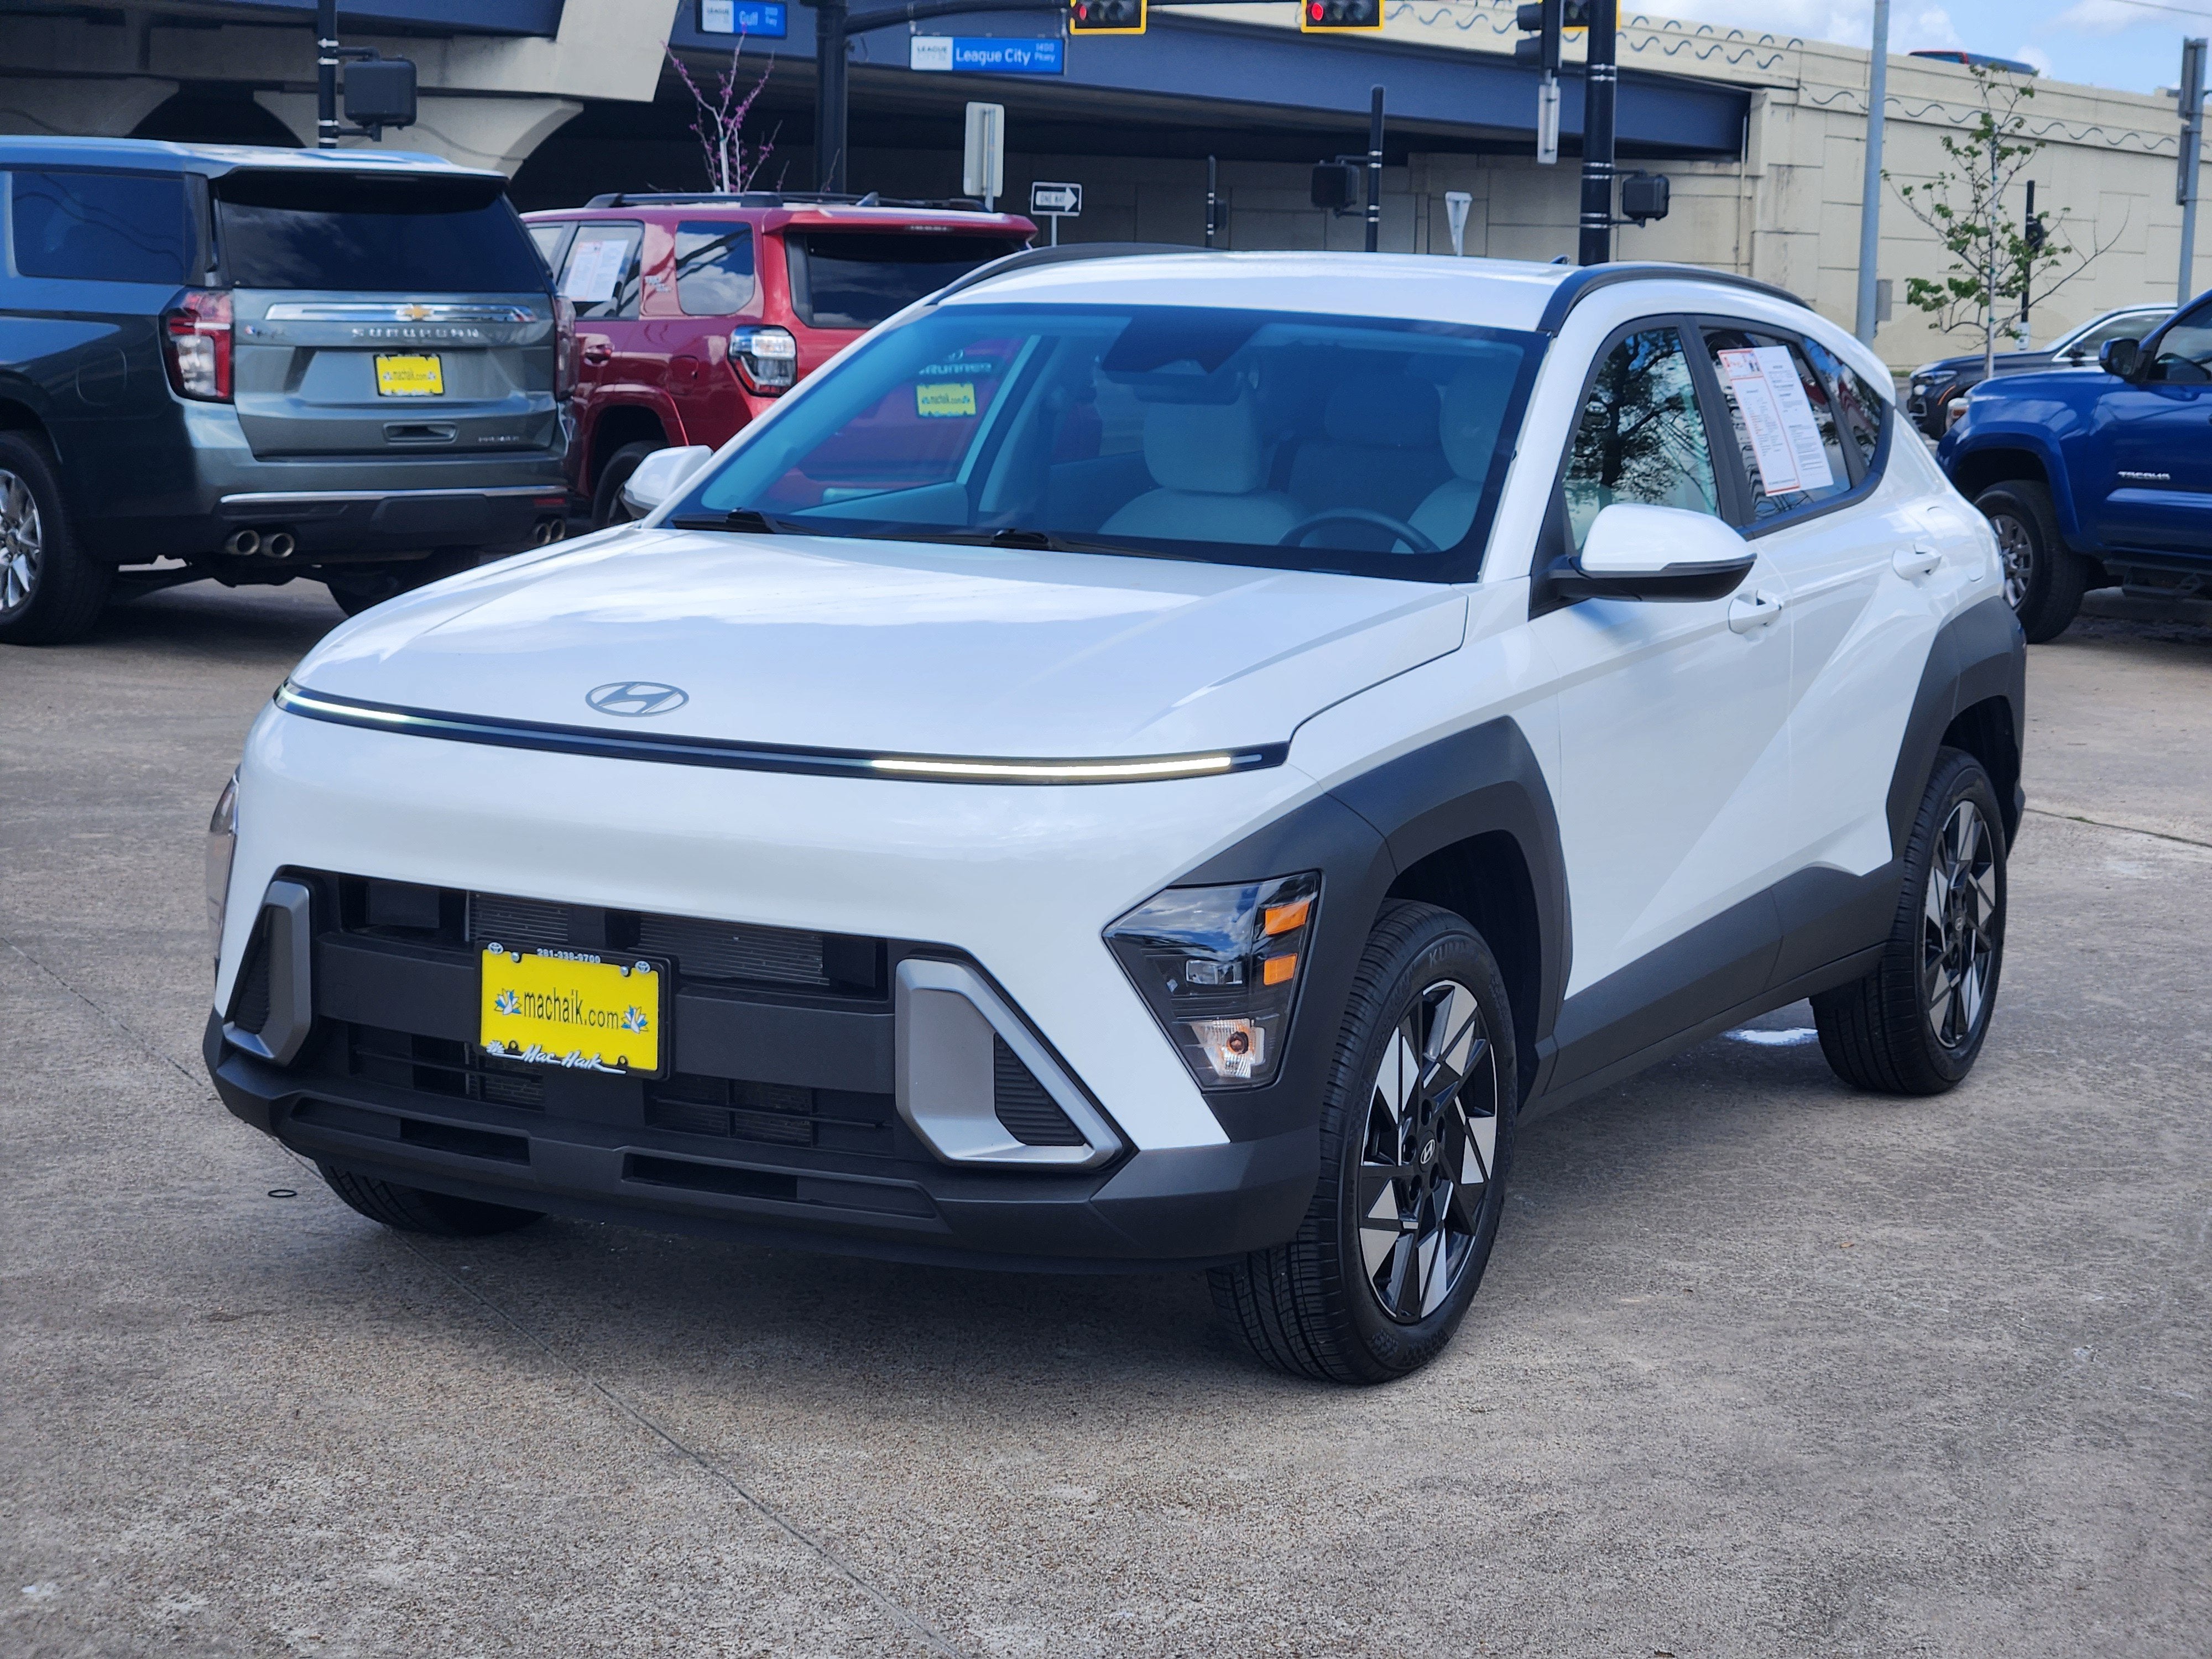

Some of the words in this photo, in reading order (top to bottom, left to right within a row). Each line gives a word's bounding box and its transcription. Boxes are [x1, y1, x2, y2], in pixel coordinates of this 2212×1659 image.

[956, 48, 1002, 66] League
[1005, 48, 1031, 66] City
[524, 987, 619, 1029] machaik.com
[523, 1044, 561, 1064] Mac
[560, 1050, 611, 1071] Haik
